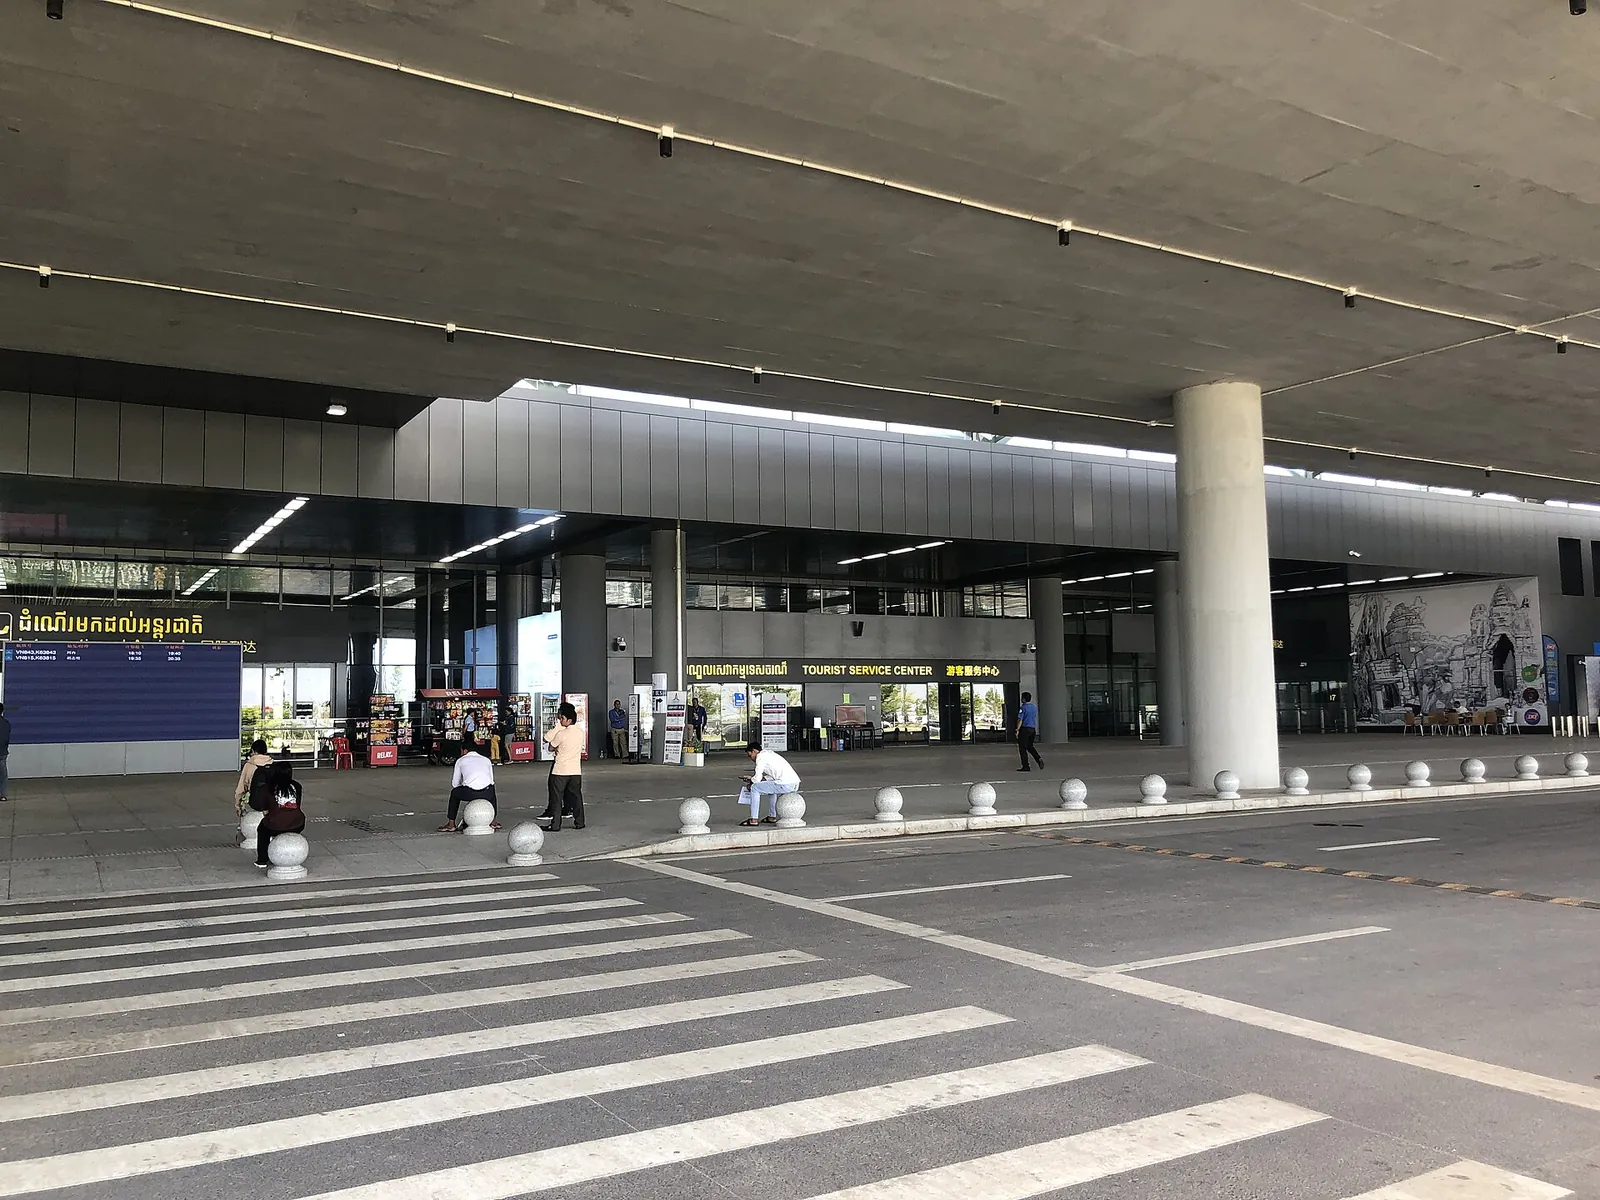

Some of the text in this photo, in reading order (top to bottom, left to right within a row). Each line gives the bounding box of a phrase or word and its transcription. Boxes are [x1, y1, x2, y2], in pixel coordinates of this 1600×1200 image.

[802, 665, 933, 676] TOURIST SERVICE CENTER
[946, 665, 1000, 677] 游客服务中心
